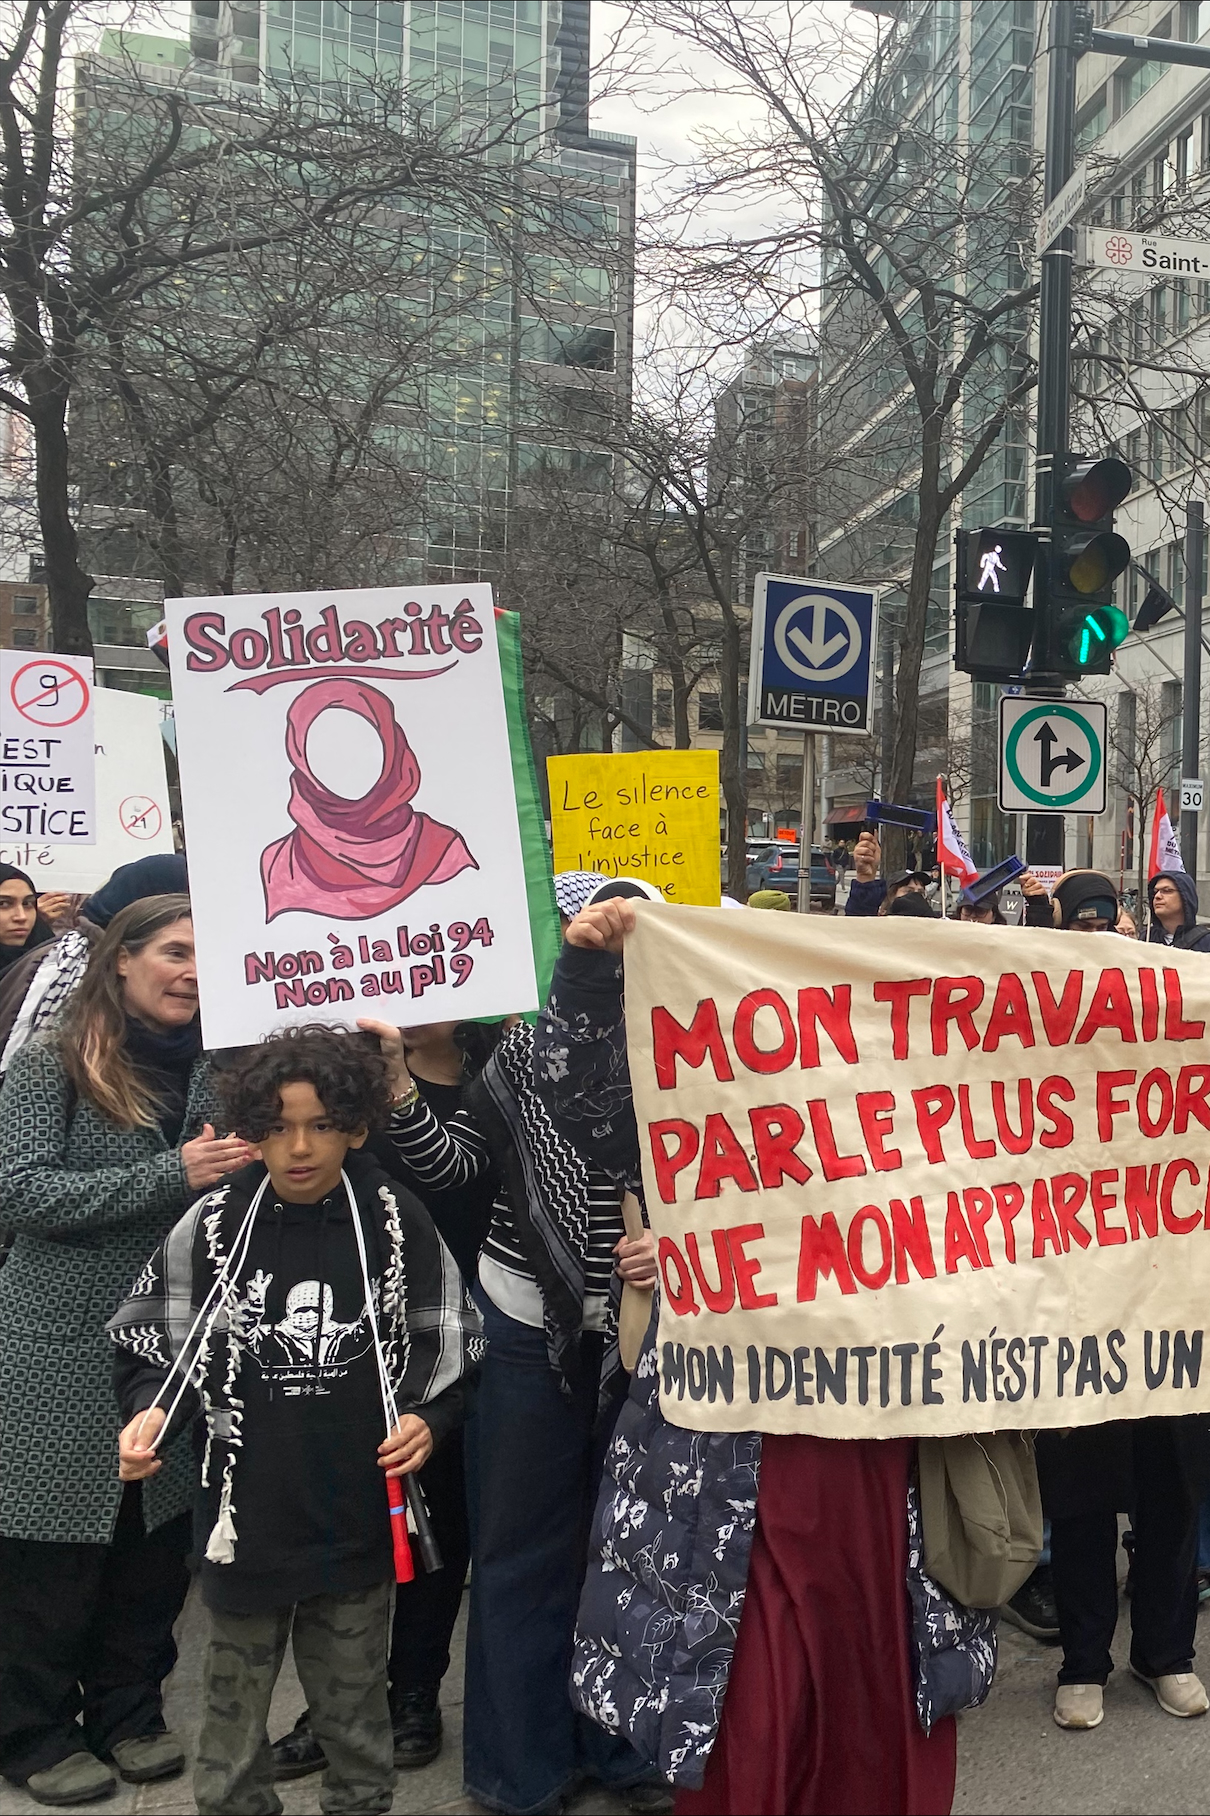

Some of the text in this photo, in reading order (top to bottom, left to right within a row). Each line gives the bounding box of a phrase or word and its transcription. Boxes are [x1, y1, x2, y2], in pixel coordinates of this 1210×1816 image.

[1141, 237, 1157, 247] Rue
[183, 598, 483, 672] Solidarité
[563, 772, 710, 811] Le silence
[1182, 792, 1202, 806] 30
[588, 812, 668, 841] face à
[578, 845, 685, 878] l'injustice
[1006, 900, 1018, 910] W
[244, 917, 494, 985] Non à la loi 94
[274, 977, 355, 1009] Non
[360, 970, 404, 997] au
[450, 953, 474, 988] 9
[651, 967, 1205, 1090] MON TRAVAIL
[649, 1091, 902, 1204] PARLE
[912, 1075, 1075, 1165] PLUS
[658, 1223, 778, 1316] QUE
[797, 1196, 937, 1302] MON
[662, 1341, 734, 1403] MON
[748, 1323, 944, 1407] IDENTITÉ
[1057, 1329, 1128, 1397] PAS
[1144, 1330, 1203, 1390] UN
